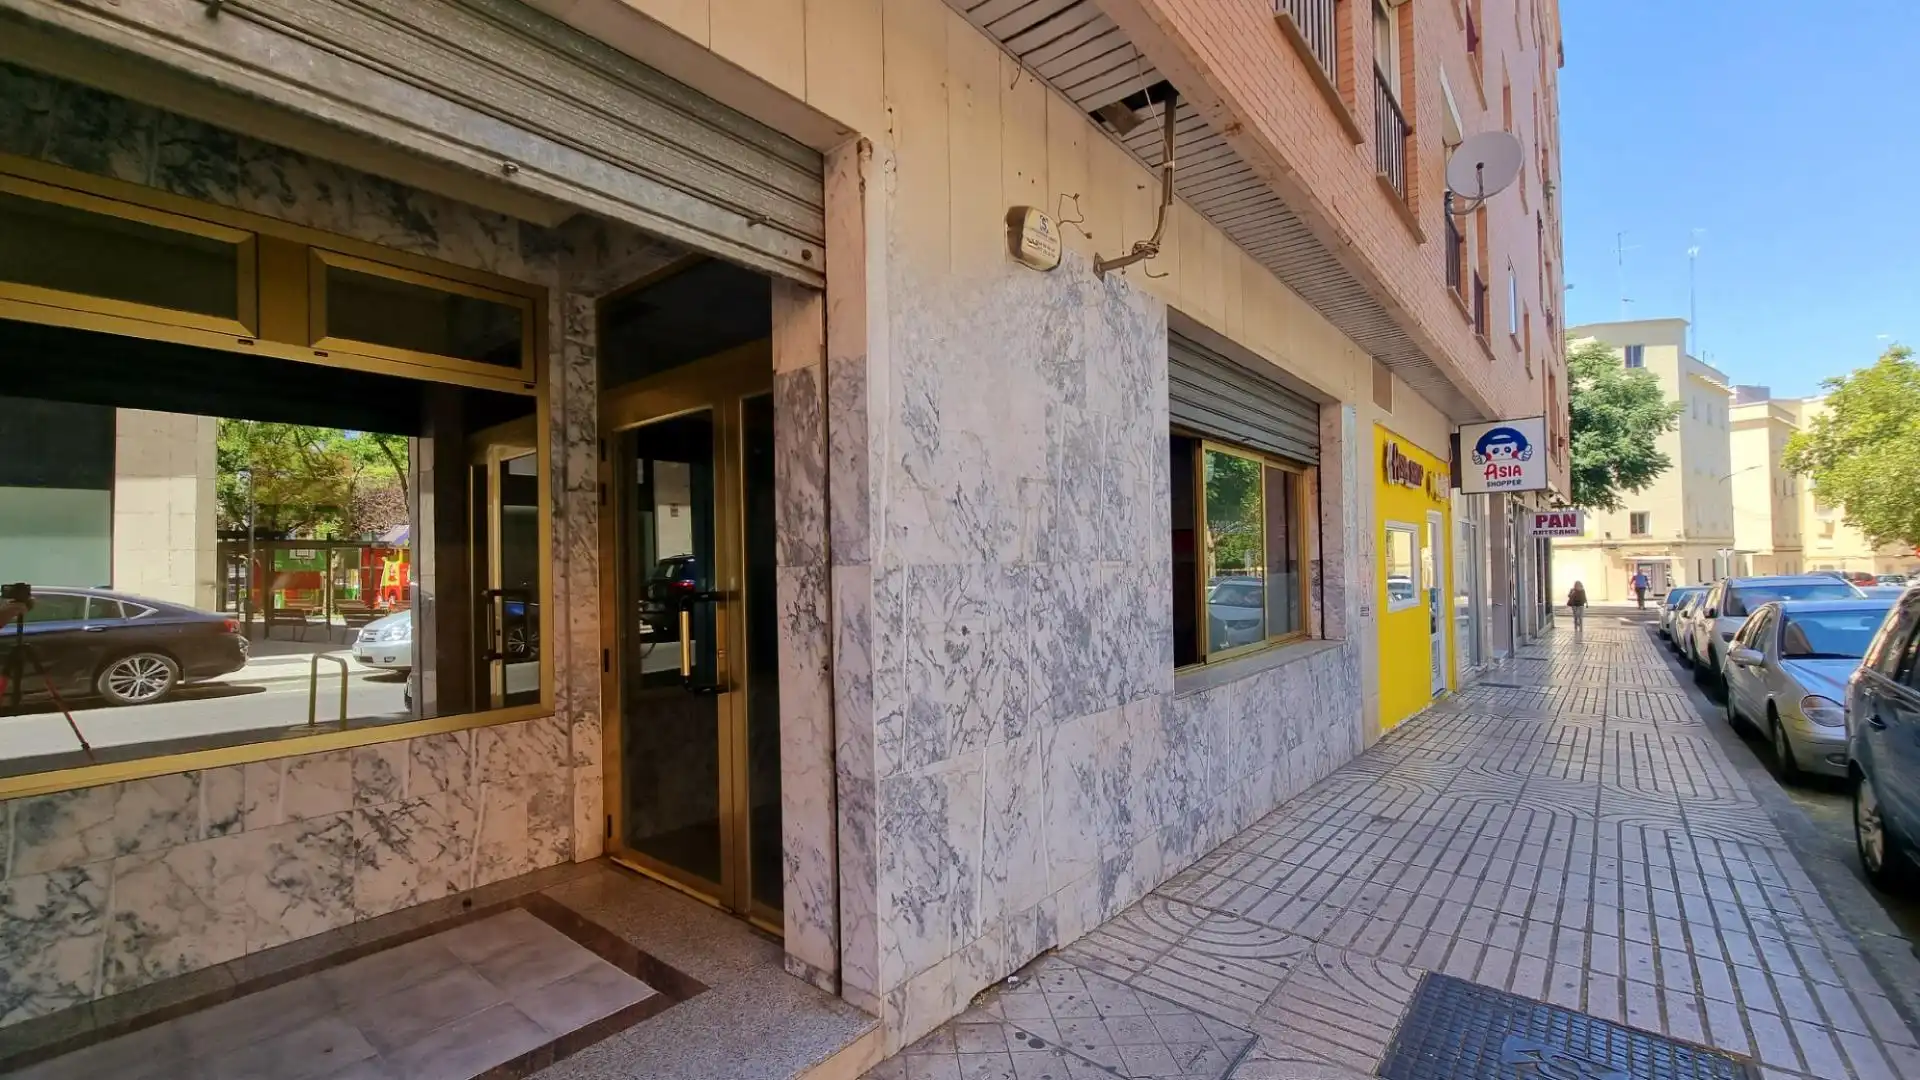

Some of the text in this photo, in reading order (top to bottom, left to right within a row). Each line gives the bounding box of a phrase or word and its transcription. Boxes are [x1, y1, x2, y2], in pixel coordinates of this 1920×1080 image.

[1484, 463, 1522, 480] ASIA
[1486, 479, 1522, 487] SHOPPER
[1535, 513, 1576, 528] PAN
